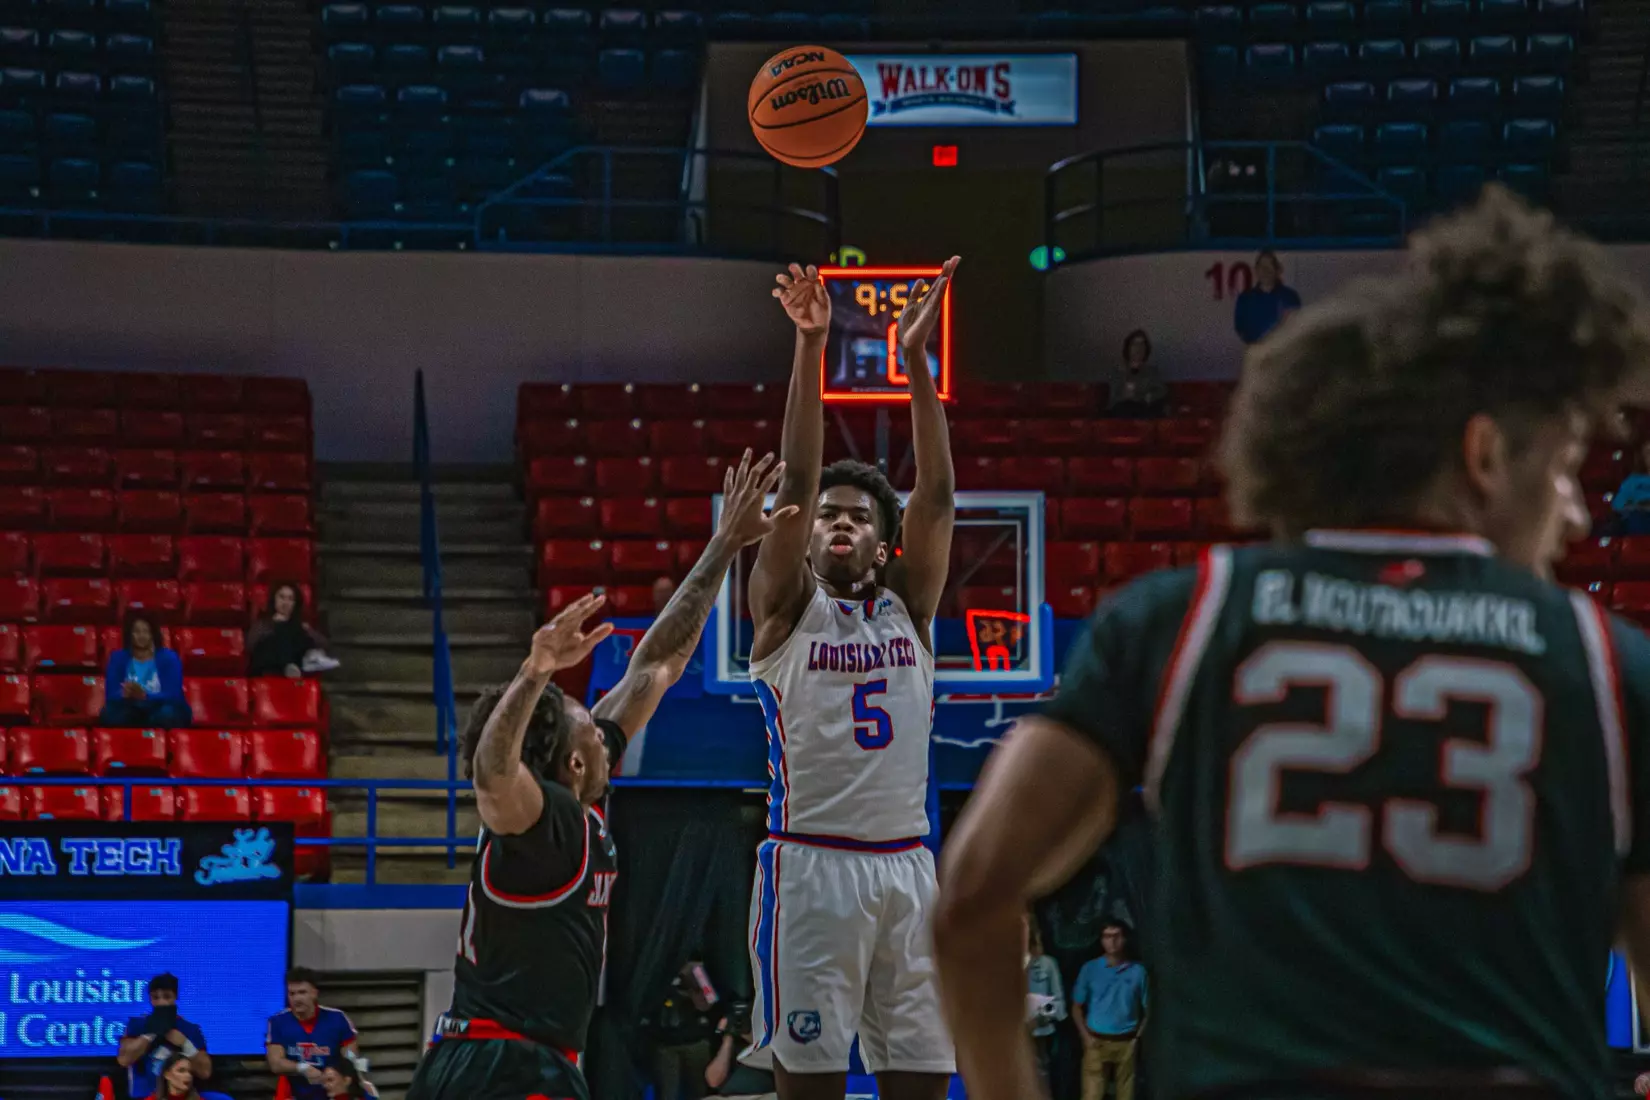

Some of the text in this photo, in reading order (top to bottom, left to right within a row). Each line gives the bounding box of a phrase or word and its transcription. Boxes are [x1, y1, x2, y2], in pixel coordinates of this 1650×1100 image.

[771, 52, 825, 76] NCAA
[771, 78, 851, 110] Wilson
[1205, 261, 1252, 300] 10
[855, 283, 930, 319] 9:5
[851, 678, 894, 751] 5
[1224, 640, 1545, 893] 23
[0, 838, 182, 875] NA TECH
[9, 967, 149, 1003] Louisia
[16, 1013, 127, 1047] Cente
